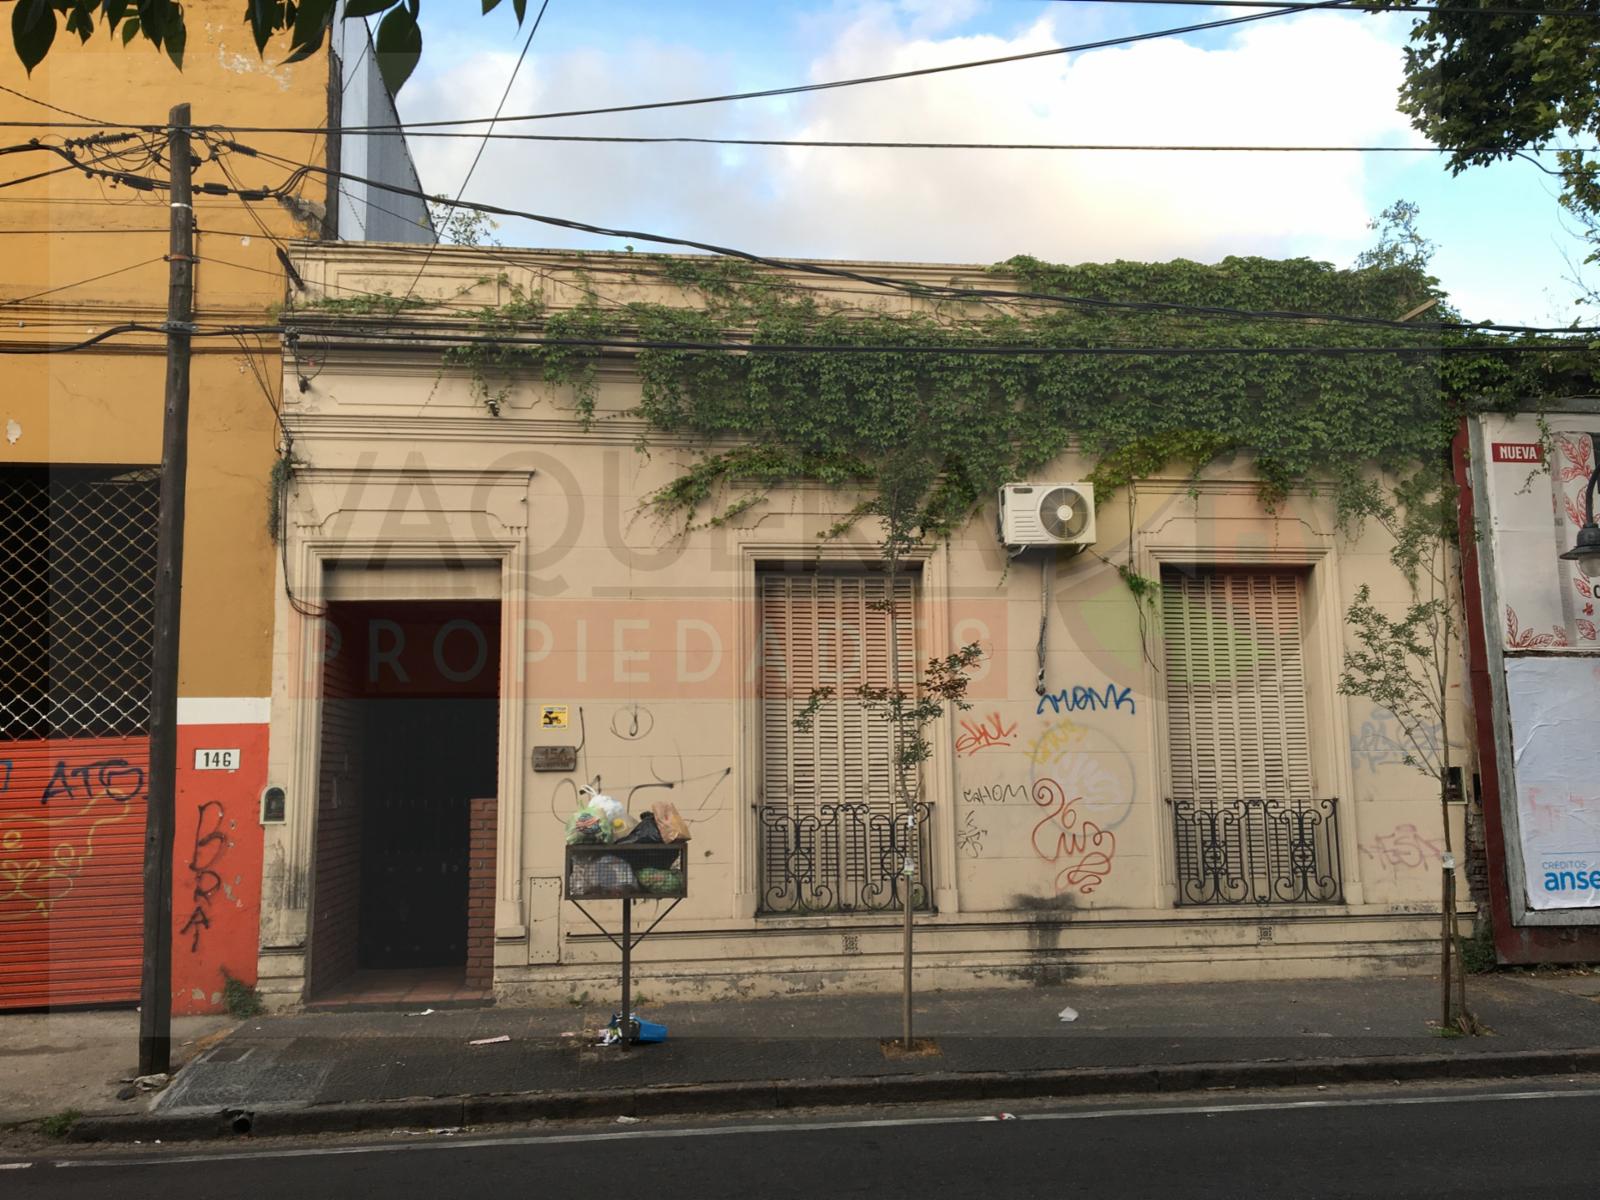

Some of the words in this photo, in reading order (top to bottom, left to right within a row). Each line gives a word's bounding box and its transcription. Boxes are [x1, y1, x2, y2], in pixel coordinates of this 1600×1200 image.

[1500, 446, 1537, 460] NUEVA
[204, 752, 231, 767] 146
[1544, 870, 1600, 891] anse
